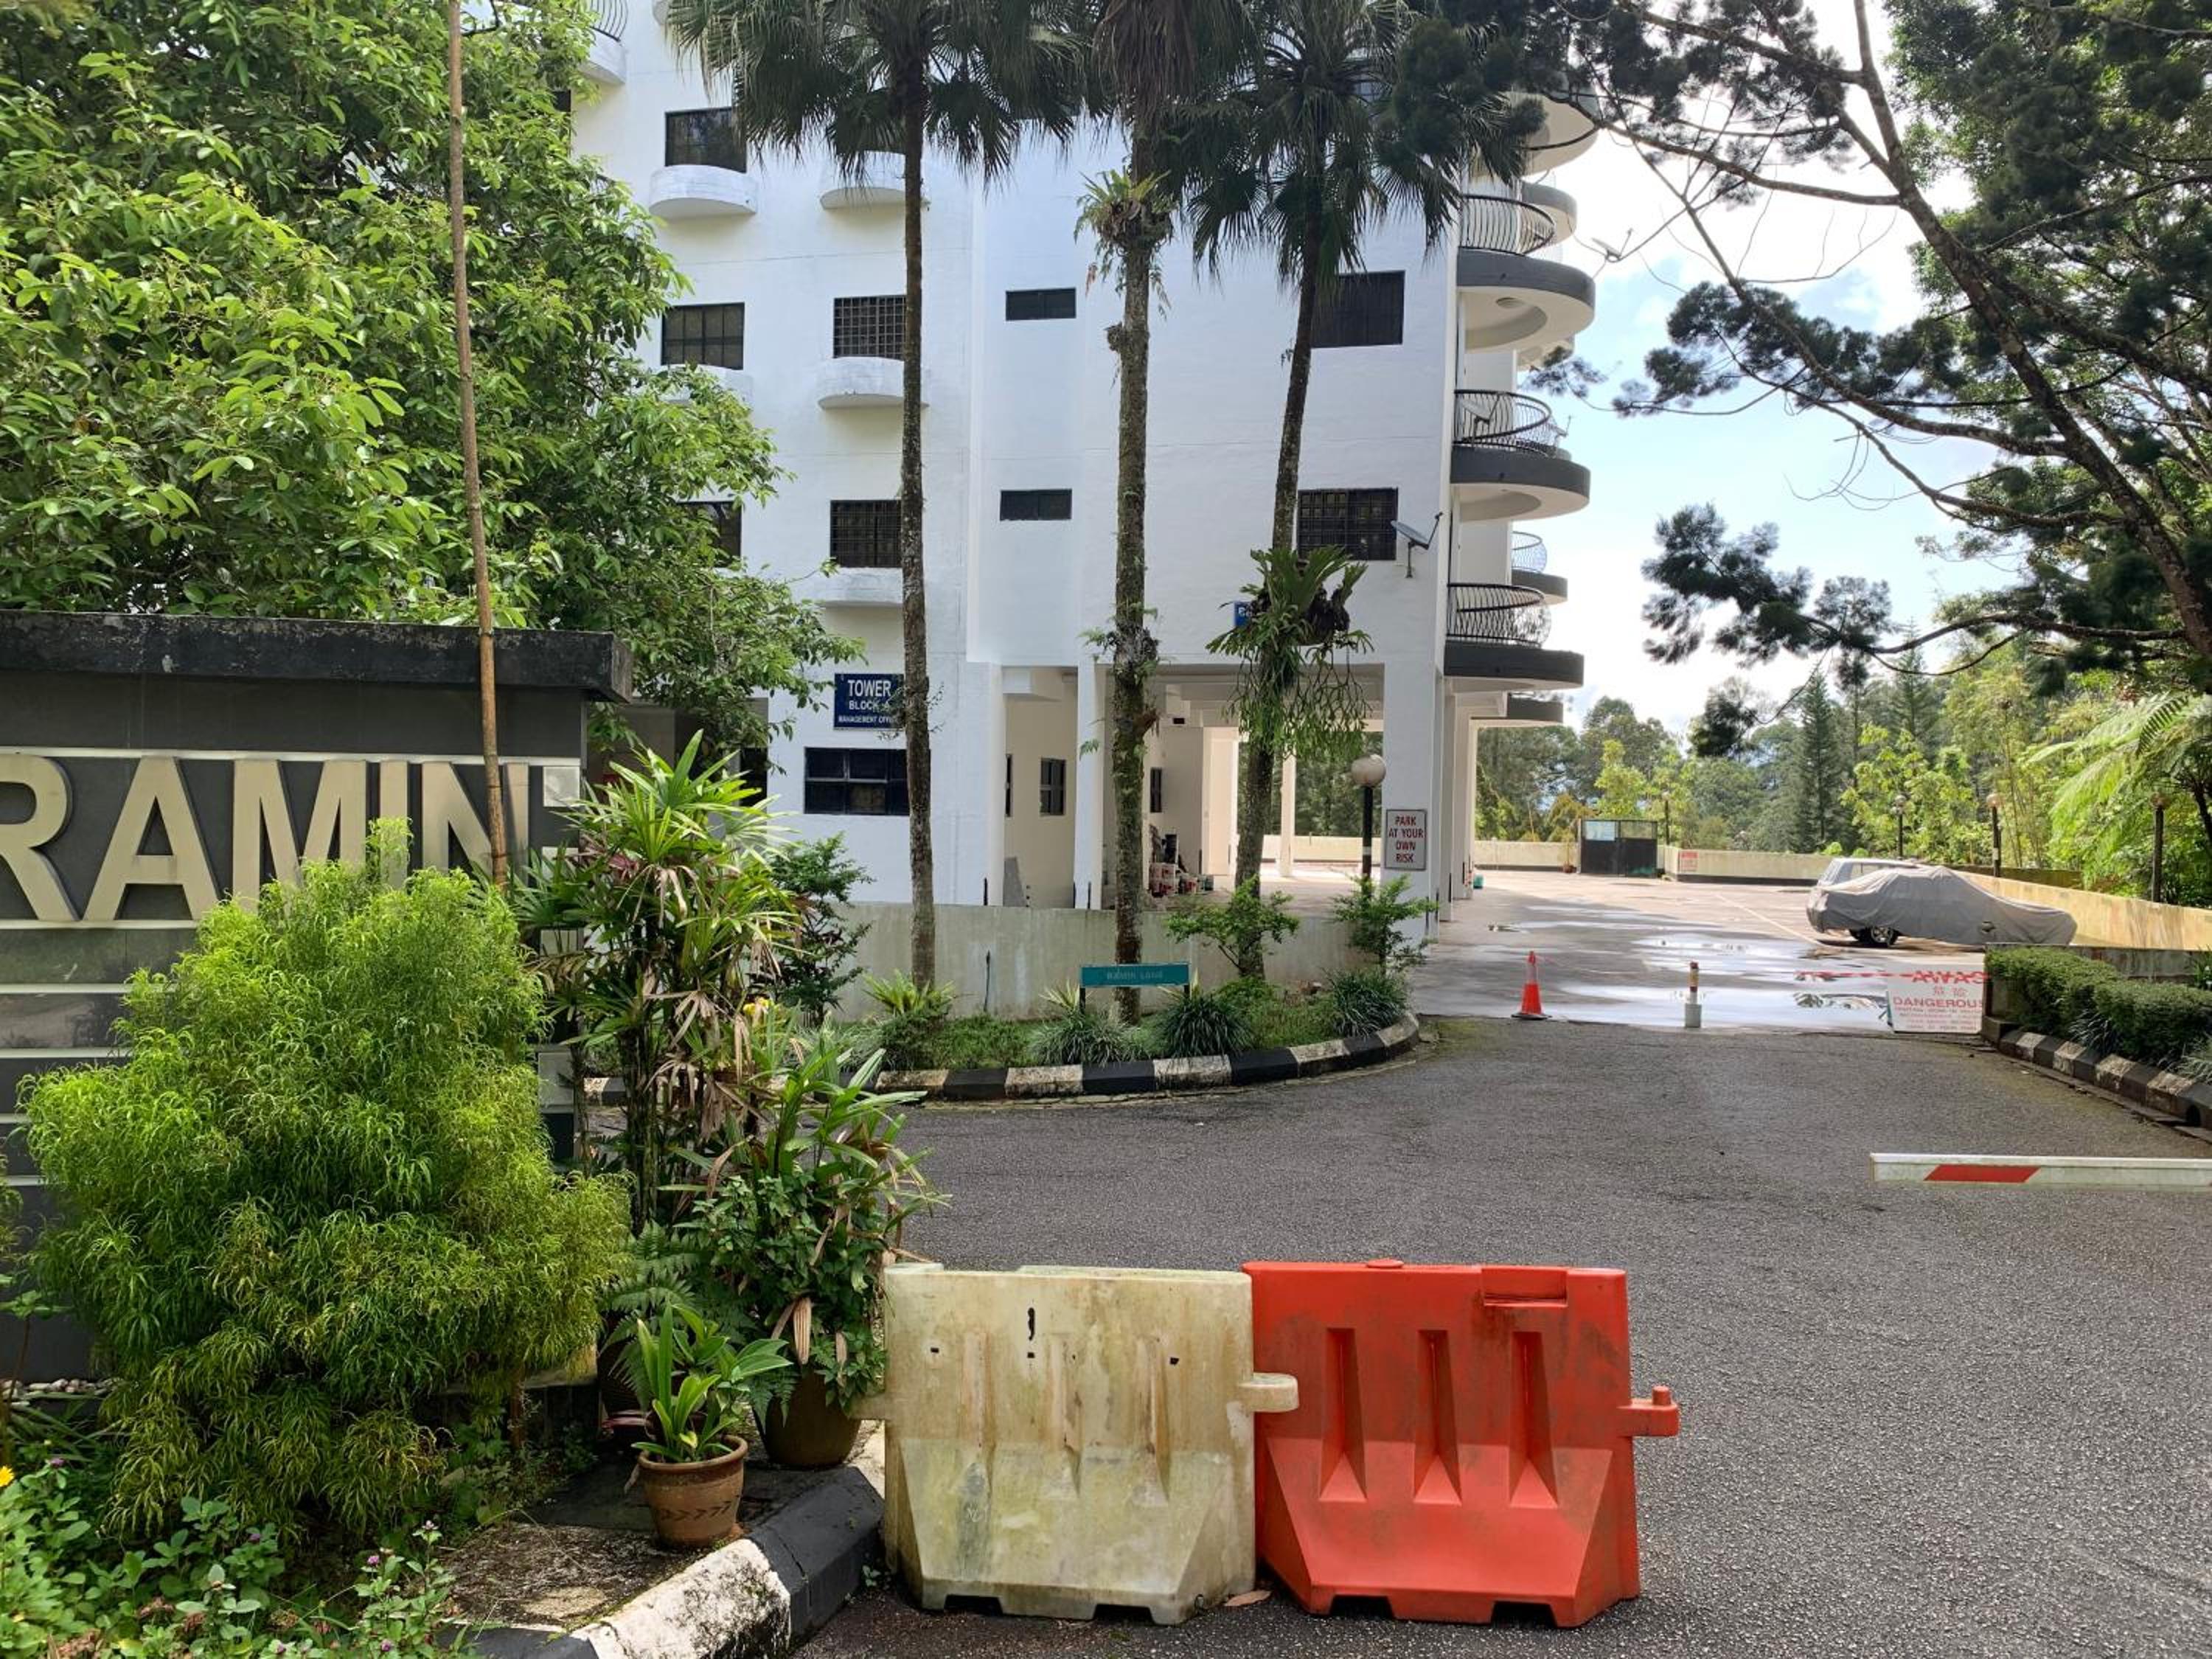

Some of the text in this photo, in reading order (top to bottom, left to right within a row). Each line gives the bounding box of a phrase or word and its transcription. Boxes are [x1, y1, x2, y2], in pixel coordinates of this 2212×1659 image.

[847, 679, 891, 697] TOWER
[849, 700, 877, 710] BLOCK
[1394, 815, 1416, 826] PARK
[0, 754, 529, 921] RAMIN
[1388, 827, 1424, 838] AT YOUR
[1396, 841, 1416, 850] OWN
[1396, 853, 1414, 863] RISK
